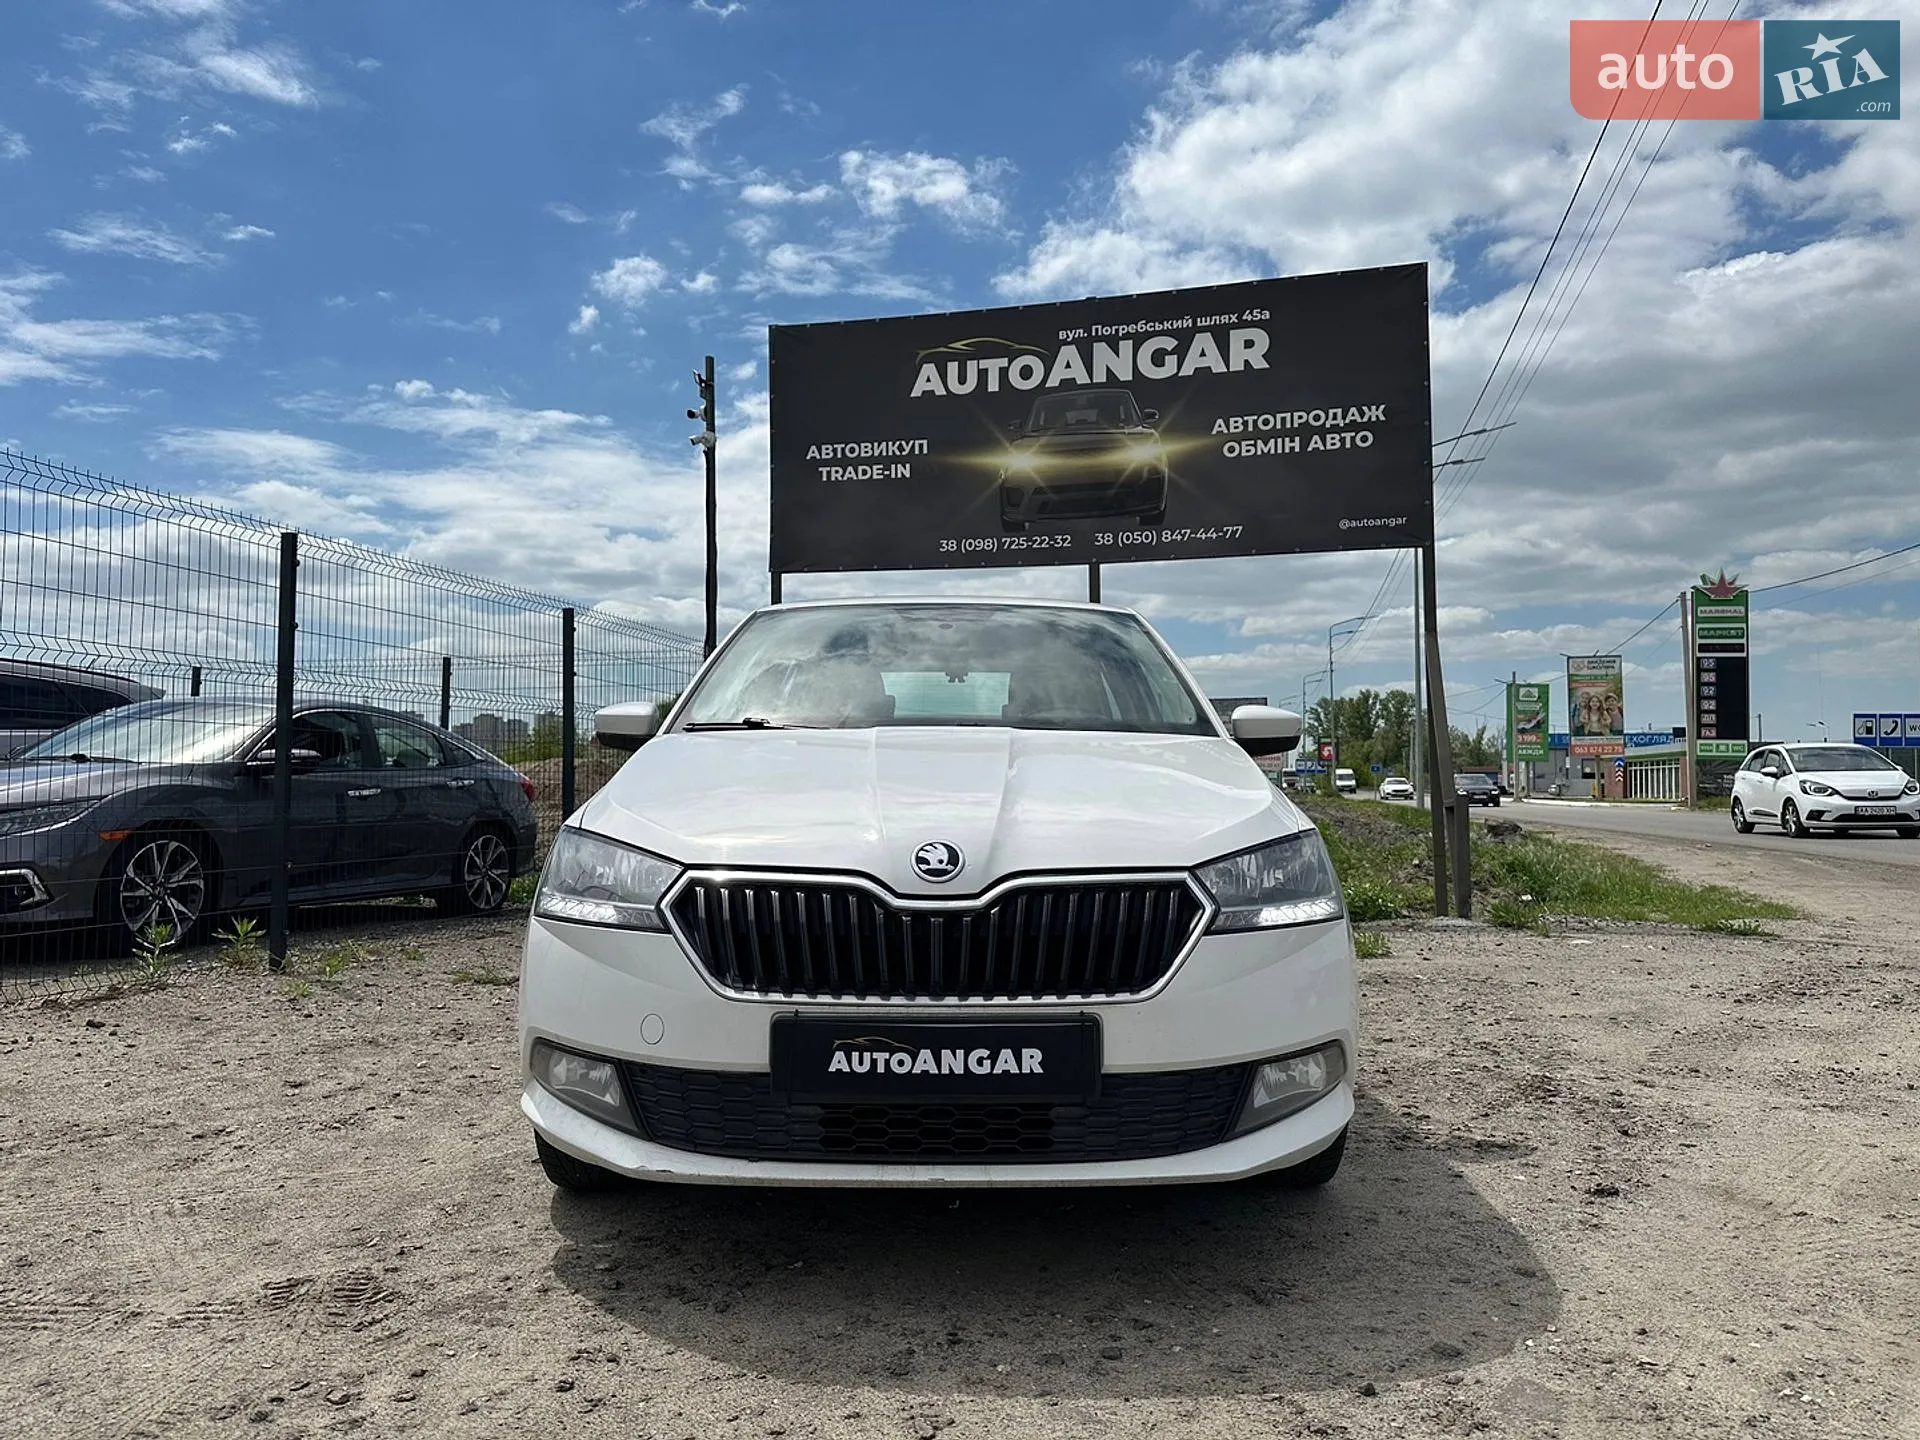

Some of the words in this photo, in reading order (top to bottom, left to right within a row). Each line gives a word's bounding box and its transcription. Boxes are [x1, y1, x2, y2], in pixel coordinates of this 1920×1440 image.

[1058, 327, 1088, 341] вул.
[1091, 316, 1193, 337] Погребський
[1197, 312, 1238, 326] шлях
[910, 327, 1271, 398] AUTOANGAR
[1211, 404, 1387, 435] АВТОПРОДАЖ
[806, 439, 929, 460] АВТОВИКУП
[1222, 436, 1300, 458] ОБМІН
[1307, 430, 1374, 451] АВТО
[818, 463, 912, 482] TRADE-IN
[1339, 516, 1408, 531] @autoangar
[939, 539, 958, 552] 38
[961, 537, 998, 553] (098)
[1002, 534, 1072, 550] 725-22-32
[1094, 533, 1114, 546] 38
[1118, 530, 1158, 546] (050)
[1161, 525, 1244, 543] 847-44-77
[1702, 658, 1715, 667] 95
[828, 1048, 1044, 1075] AUTOANGAR
